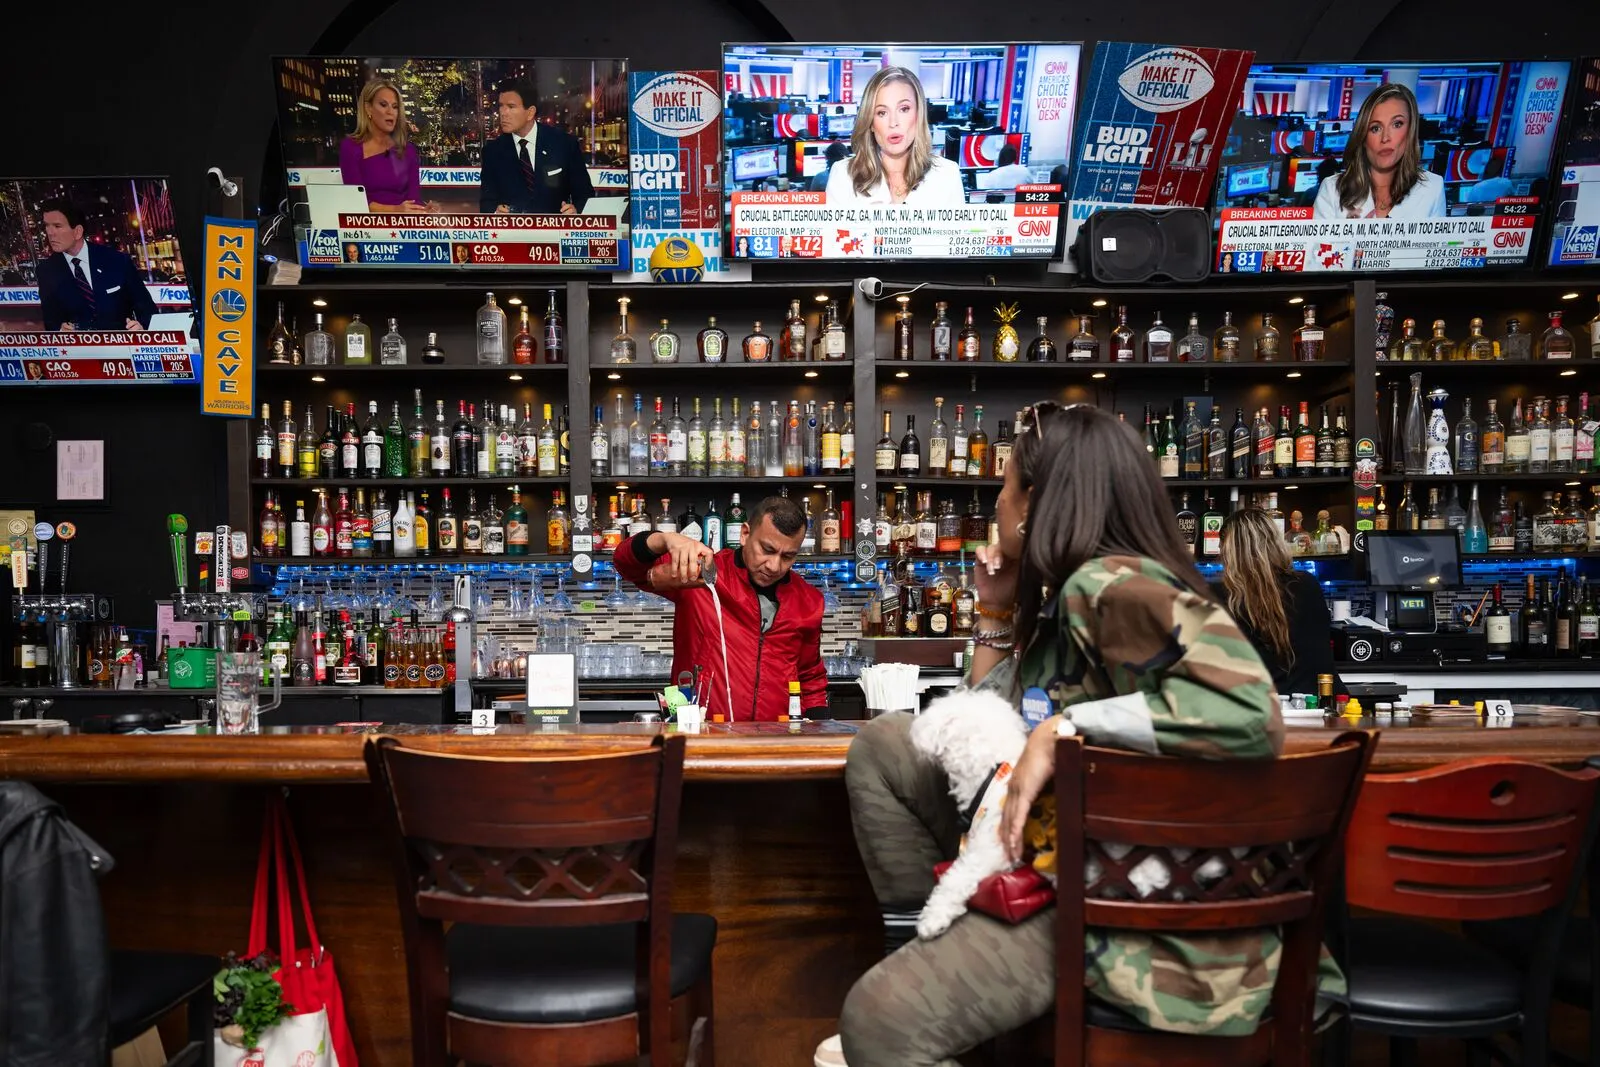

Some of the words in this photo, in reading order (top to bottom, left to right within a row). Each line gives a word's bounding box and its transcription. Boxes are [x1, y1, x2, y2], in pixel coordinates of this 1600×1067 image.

[1045, 62, 1067, 74] CNN
[1039, 75, 1070, 84] AMERICA'S
[1141, 66, 1179, 83] MAKE
[1182, 68, 1197, 84] IT
[1536, 77, 1558, 90] CNN
[1037, 84, 1069, 96] CHOICE
[1137, 81, 1191, 99] OFFICIAL
[1528, 91, 1559, 100] AMERICA'S
[653, 92, 687, 107] MAKE
[692, 91, 703, 107] IT
[1037, 97, 1067, 109] VOTING
[1526, 100, 1556, 112] CHOICE
[653, 107, 703, 123] OFFICIAL
[1039, 109, 1060, 121] DESK
[1524, 112, 1554, 124] VOTING
[1097, 126, 1148, 145] BUD
[1525, 124, 1546, 136] DESK
[1083, 144, 1152, 165] LIGHT
[630, 154, 676, 171] BUD
[427, 172, 449, 182] FOX
[450, 172, 480, 182] NEWS
[606, 173, 628, 183] FOX
[631, 171, 684, 190] IGHT
[741, 194, 788, 203] BREAKING
[791, 194, 819, 203] NEWS
[1025, 193, 1049, 201] 54:22
[741, 210, 770, 221] CRUCIAL
[773, 210, 833, 221] BATTLEGROUNDS
[834, 210, 844, 221] OF
[927, 210, 937, 221] WI
[938, 209, 952, 221] TOO
[954, 209, 977, 221] EARLY
[979, 209, 989, 221] TO
[990, 209, 1008, 221] CALL
[1025, 205, 1048, 214] LIVE
[1230, 210, 1277, 219] BREAKING
[1280, 209, 1307, 218] NEWS
[1504, 205, 1527, 214] 54:22
[346, 216, 388, 226] PIVOTAL
[391, 216, 470, 227] BATTLEGROUND
[474, 217, 508, 227] STATES
[512, 217, 533, 227] TOO
[536, 217, 566, 227] EARLY
[569, 217, 583, 227] TO
[585, 217, 609, 227] CALL
[1501, 218, 1525, 227] LIVE
[751, 228, 788, 236] ELECTORAL
[898, 227, 932, 235] CAROLINA
[1018, 220, 1051, 237] CNN
[1228, 226, 1257, 238] CRUCIAL
[1259, 225, 1318, 238] BATTLEGROUNDS
[1319, 225, 1329, 236] OF
[1408, 223, 1418, 234] WI
[1418, 223, 1433, 234] TOO
[1434, 222, 1457, 234] EARLY
[1457, 222, 1468, 233] TO
[1468, 221, 1485, 233] CALL
[317, 236, 338, 246] FOX
[399, 231, 450, 239] VIRGINIA
[453, 231, 489, 240] SENATE
[1493, 232, 1527, 248] CNN
[1574, 232, 1595, 242] FOX
[753, 236, 774, 251] 81
[794, 236, 821, 251] 172
[884, 237, 912, 245] TRUMP
[949, 237, 986, 246] 2,024,637
[1237, 243, 1273, 251] ELECTORAL
[1274, 242, 1290, 250] MAP
[1566, 242, 1595, 252] NEWS
[312, 246, 340, 255] NEWS
[419, 245, 449, 261] 51.0%
[474, 245, 498, 255] CAO
[528, 246, 559, 262] 49.0%
[569, 247, 581, 257] 117
[597, 247, 610, 257] 205
[883, 246, 912, 255] HARRIS
[949, 247, 986, 255] 1,812,236
[1363, 250, 1391, 258] TRUMP
[1426, 249, 1462, 258] 2,024,637
[218, 234, 244, 281] MAN
[1237, 252, 1257, 266] 81
[1276, 251, 1303, 265] 172
[1361, 260, 1390, 268] HARRIS
[1424, 259, 1460, 268] 1,812,236
[8, 290, 40, 301] NEWS
[168, 289, 191, 300] FOX
[41, 334, 76, 344] STATES
[77, 333, 101, 344] TOO
[103, 333, 134, 344] EARLY
[136, 333, 151, 343] TO
[153, 333, 179, 343] CALL
[21, 347, 59, 357] SENATE
[46, 362, 71, 371] CAO
[142, 362, 155, 371] 117
[170, 361, 184, 371] 205
[217, 330, 242, 394] CAVE
[102, 361, 133, 377] 49.0%
[206, 402, 250, 410] WARRIORS
[1401, 600, 1424, 608] YETI
[1495, 705, 1507, 716] 6
[479, 714, 488, 726] 3
